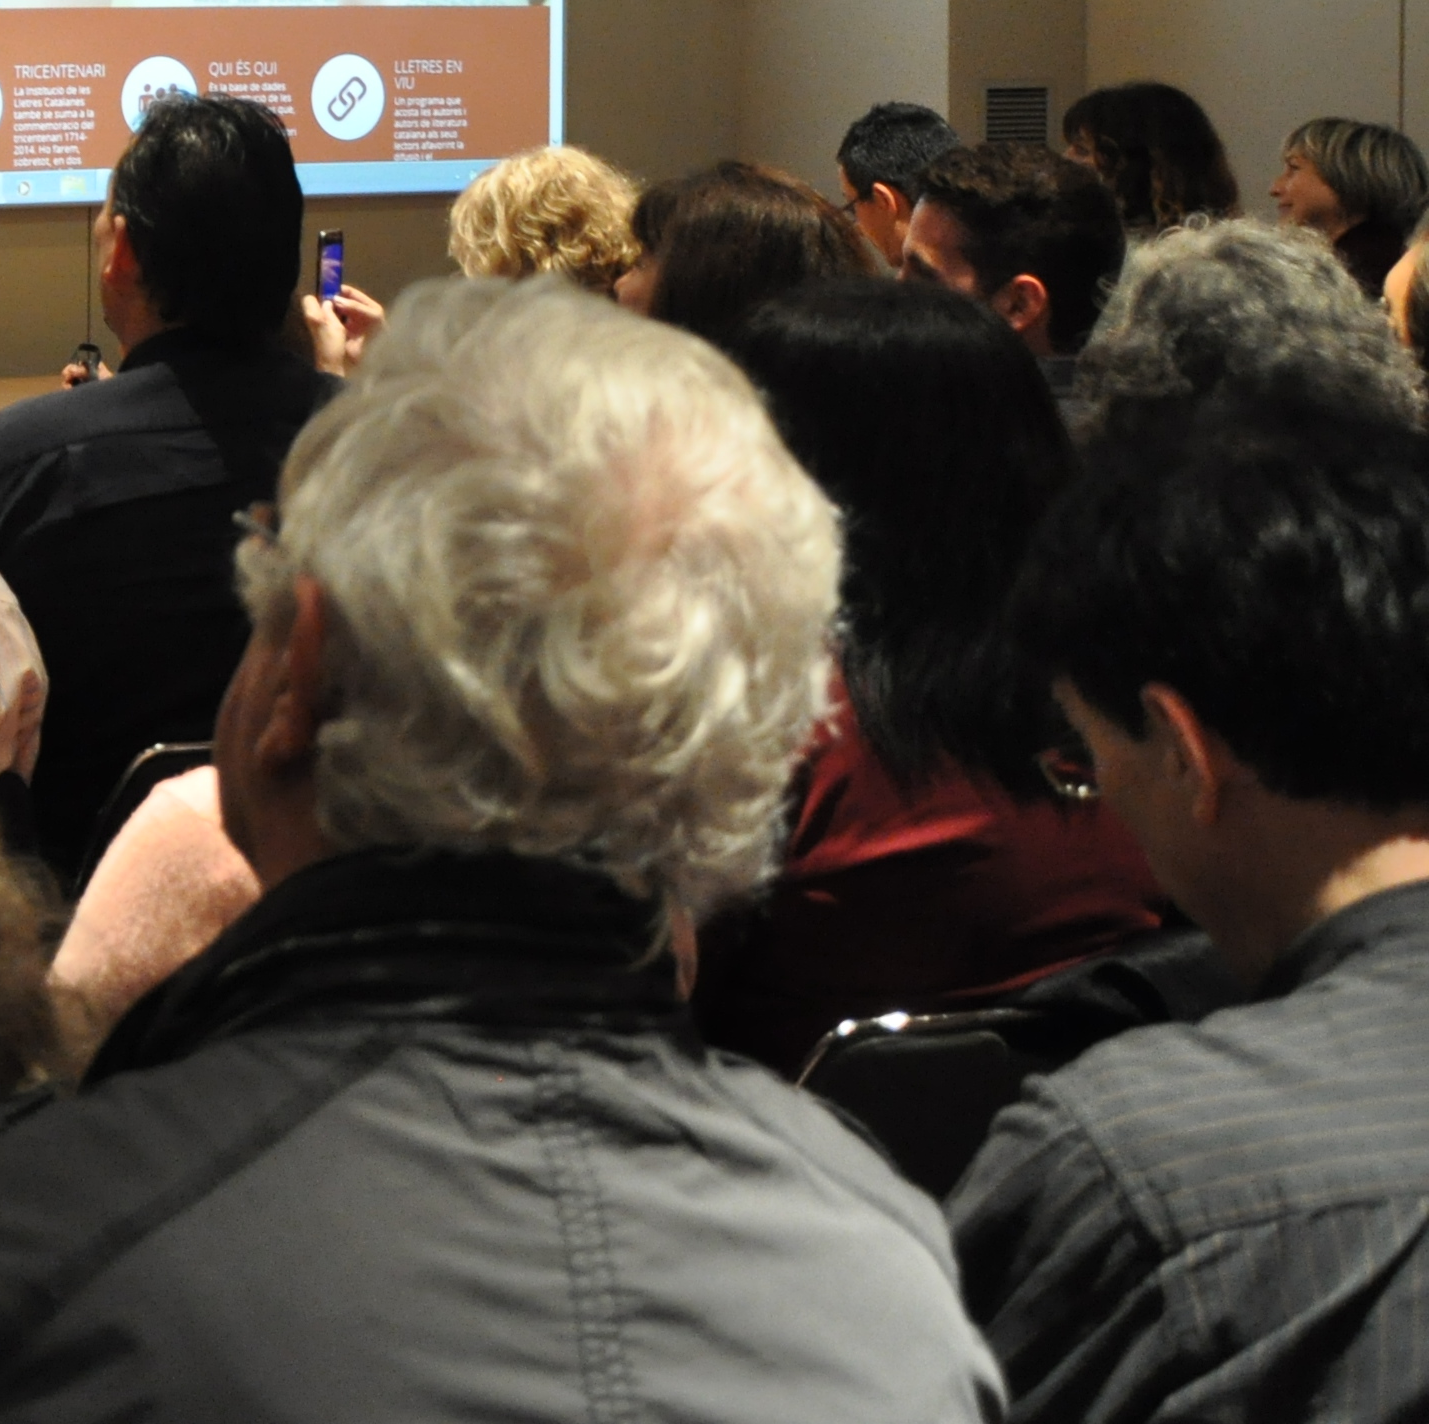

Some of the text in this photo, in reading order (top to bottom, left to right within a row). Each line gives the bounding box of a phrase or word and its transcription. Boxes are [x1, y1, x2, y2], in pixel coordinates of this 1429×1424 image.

[14, 64, 106, 79] TRICENTENARI
[209, 59, 277, 77] QUI ÉS QUI
[394, 60, 462, 74] LLETRES EN
[394, 77, 415, 90] VIU
